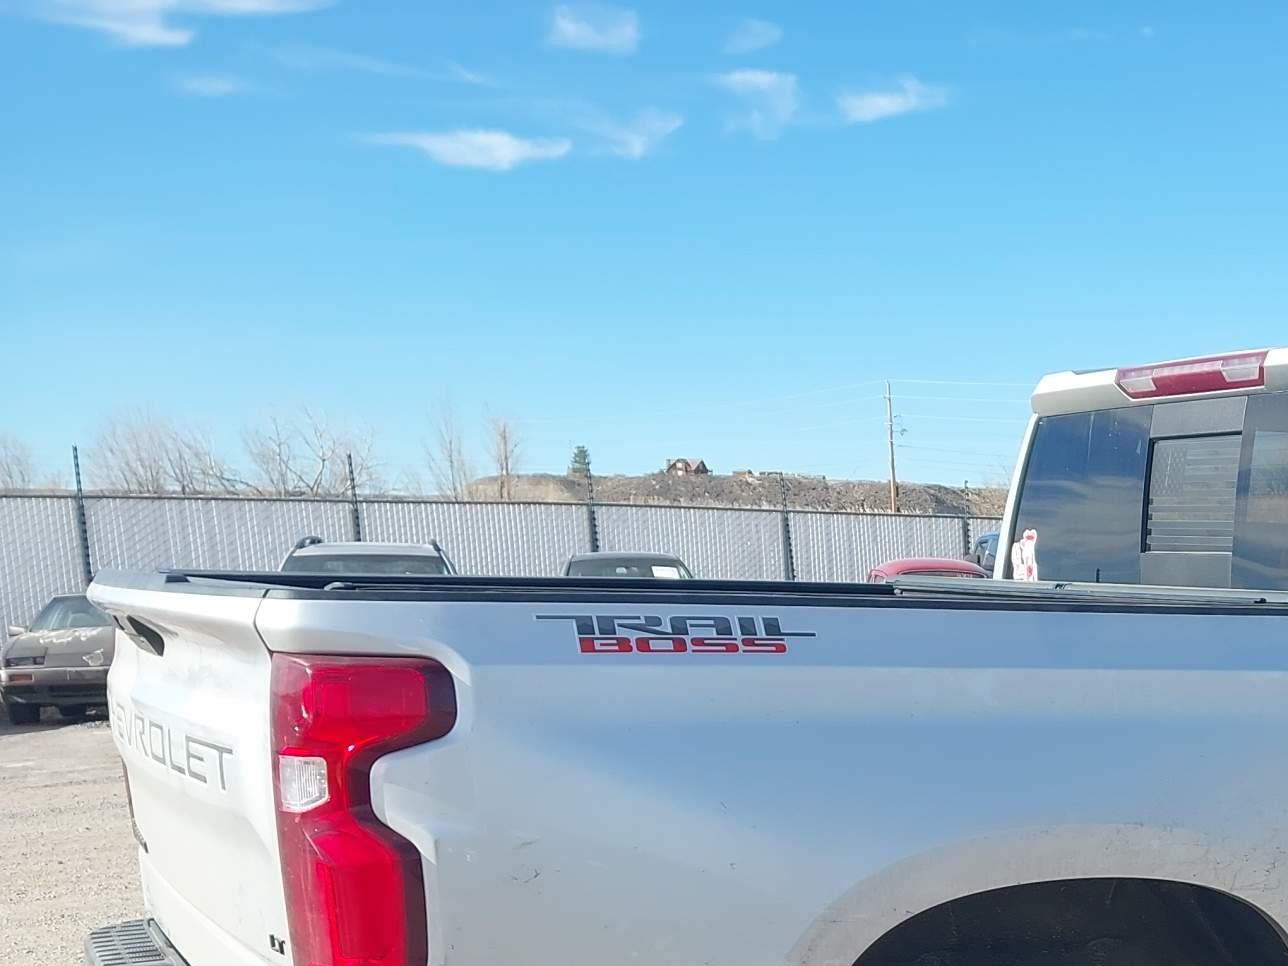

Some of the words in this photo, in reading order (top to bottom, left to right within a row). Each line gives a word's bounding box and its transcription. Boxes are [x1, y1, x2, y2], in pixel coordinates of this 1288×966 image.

[534, 614, 817, 637] TRAIL
[578, 636, 788, 654] BOSS
[111, 698, 234, 791] EVROLET
[269, 933, 286, 956] LT
